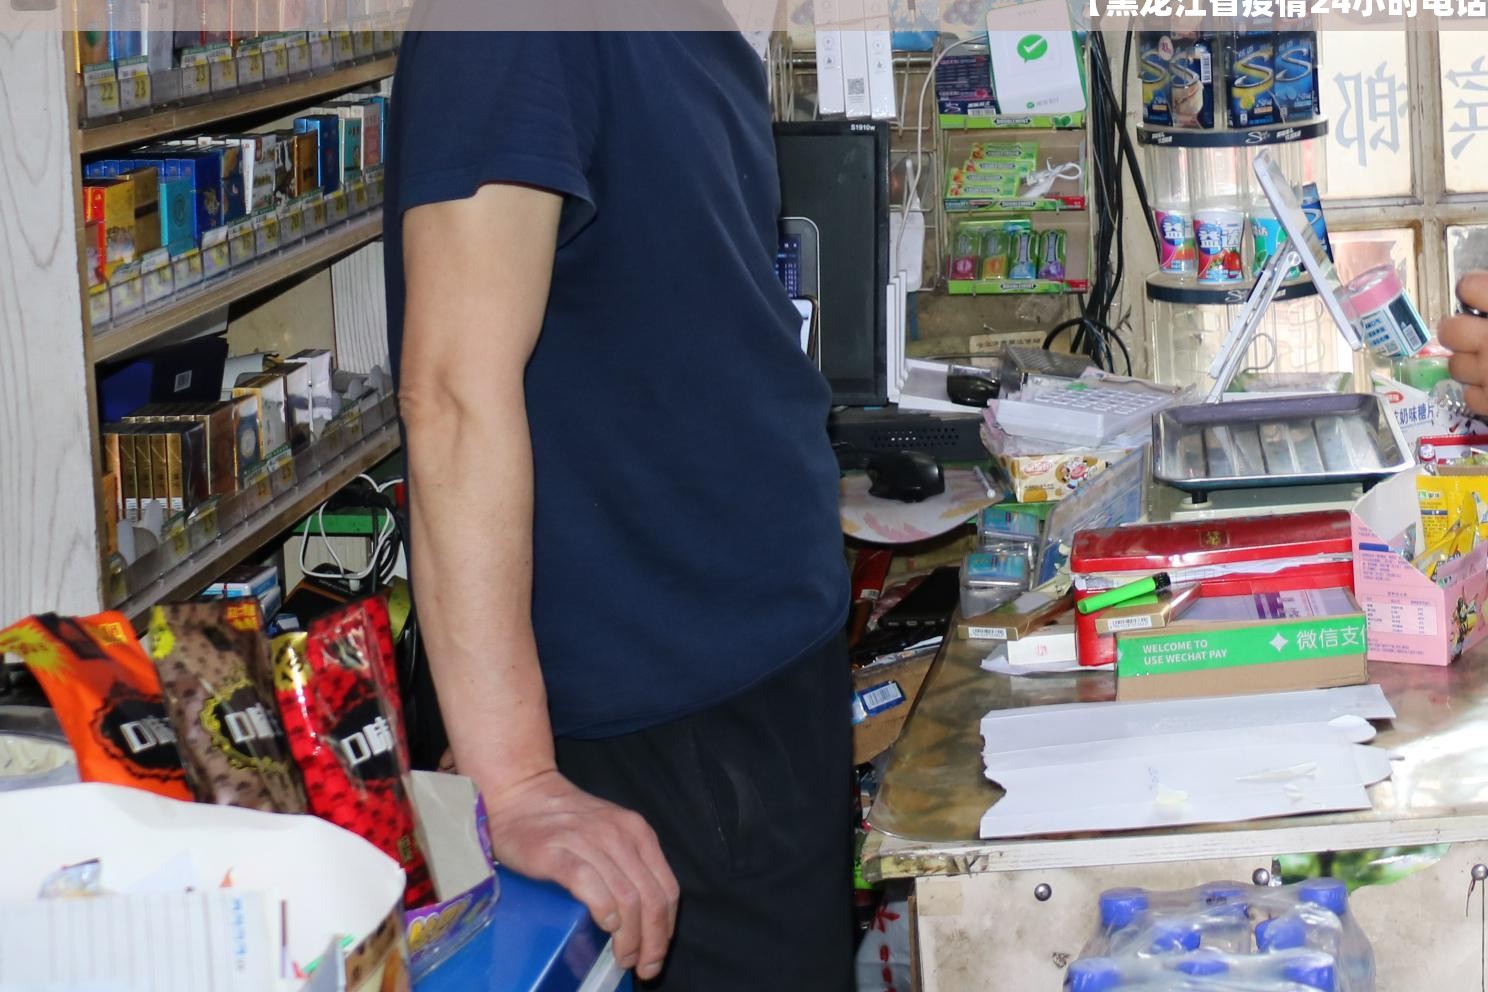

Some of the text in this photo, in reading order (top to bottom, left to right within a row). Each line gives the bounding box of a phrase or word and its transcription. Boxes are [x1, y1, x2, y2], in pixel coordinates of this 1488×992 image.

[1143, 639, 1208, 654] WELCOME TO
[1144, 649, 1227, 665] USE WECHAT PAY
